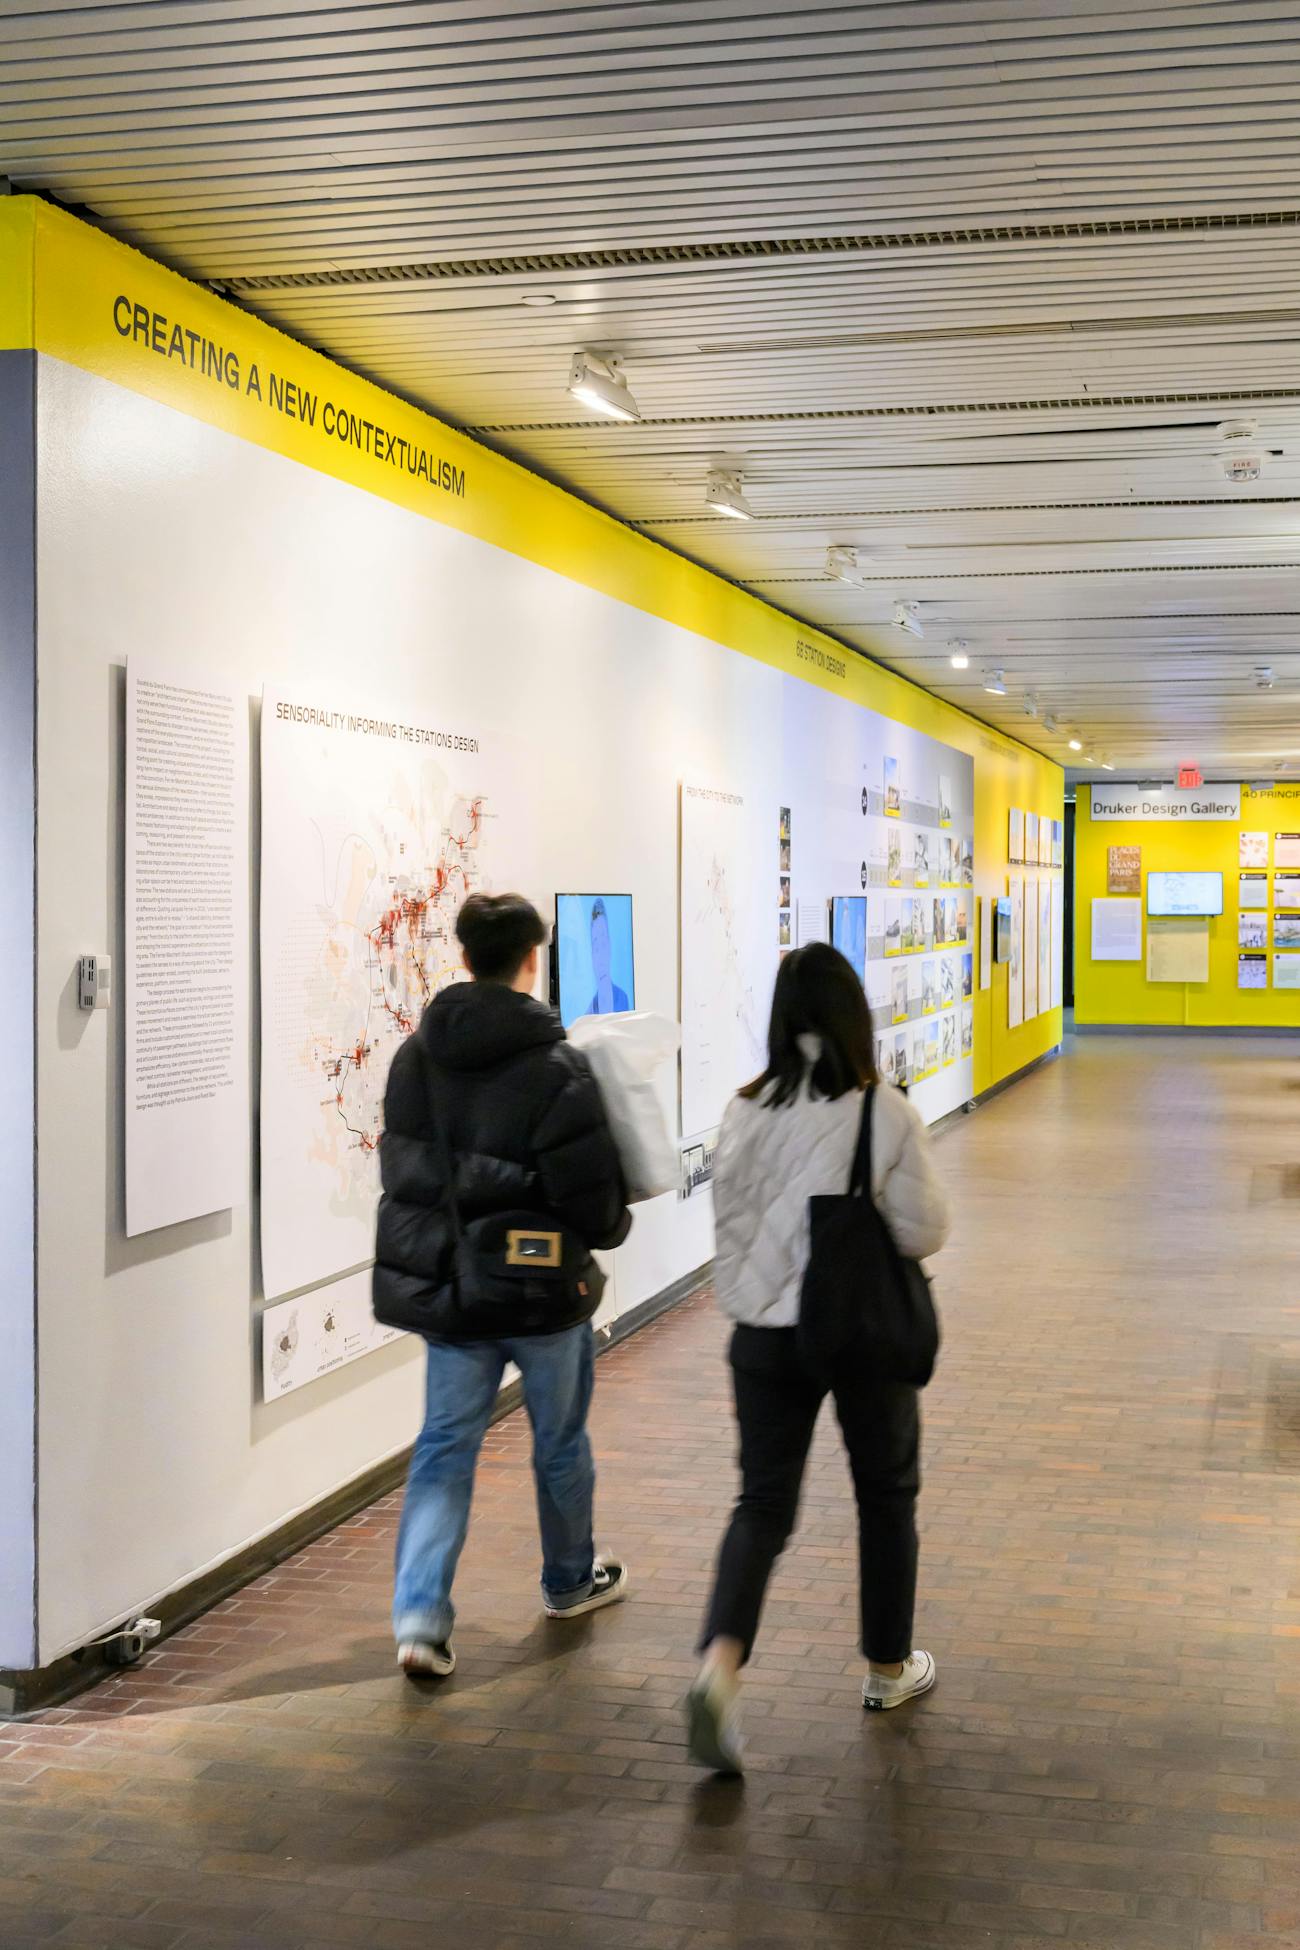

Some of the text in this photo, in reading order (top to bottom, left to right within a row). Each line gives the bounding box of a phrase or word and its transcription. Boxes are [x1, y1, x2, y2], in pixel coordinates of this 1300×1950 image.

[113, 295, 465, 498] CREATING A NEW CONTEXTUALISM
[804, 644, 826, 669] STATION
[276, 702, 480, 753] SENSORIALITY INFORMING THE STATIONS DESIGN
[1093, 801, 1237, 816] Druker Design Gallery
[1109, 861, 1140, 869] GRAND
[1109, 869, 1133, 877] PARIS
